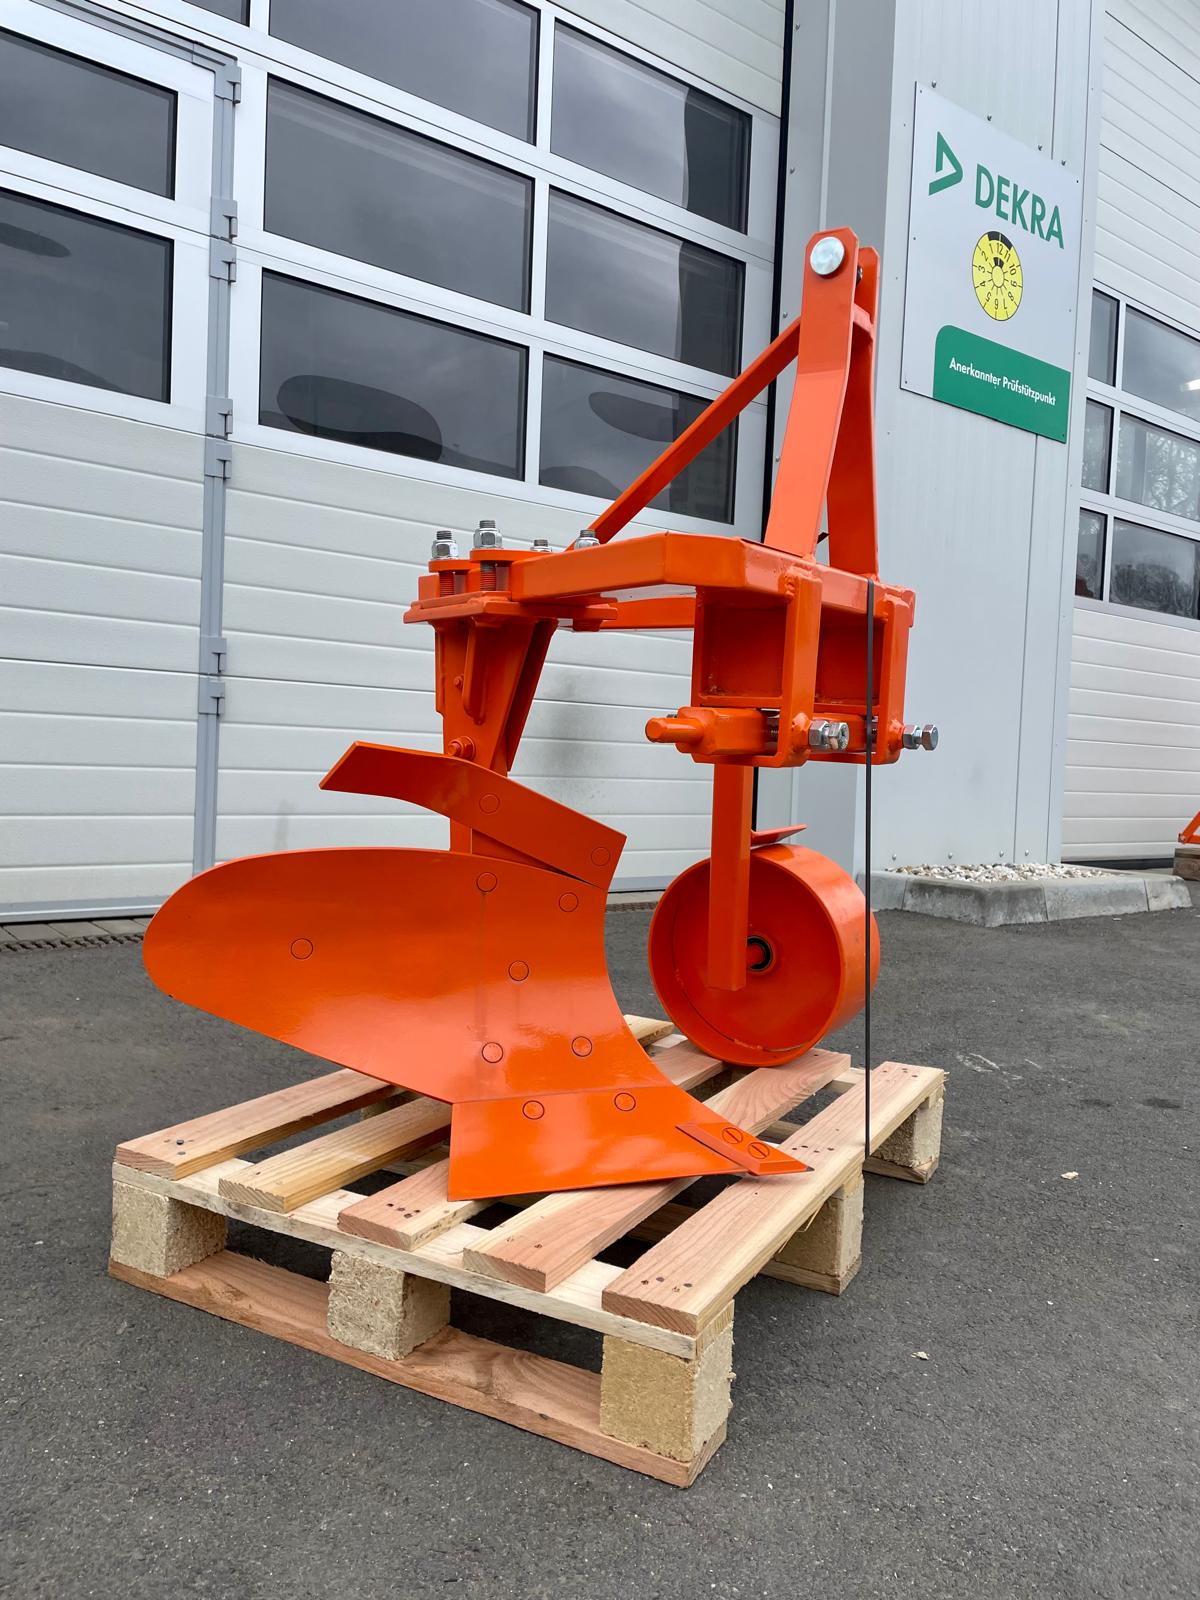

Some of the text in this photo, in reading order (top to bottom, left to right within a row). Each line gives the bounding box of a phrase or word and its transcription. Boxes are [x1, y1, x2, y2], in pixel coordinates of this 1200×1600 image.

[975, 163, 1064, 249] DEKRA
[997, 243, 1003, 255] 12
[981, 251, 988, 261] 2
[1004, 250, 1011, 262] 11
[978, 265, 985, 273] 3
[1009, 263, 1016, 275] 10
[986, 291, 991, 302] 5
[1008, 291, 1014, 301] 8
[949, 357, 1056, 405] Anerkannter Prüfstützpunkt
